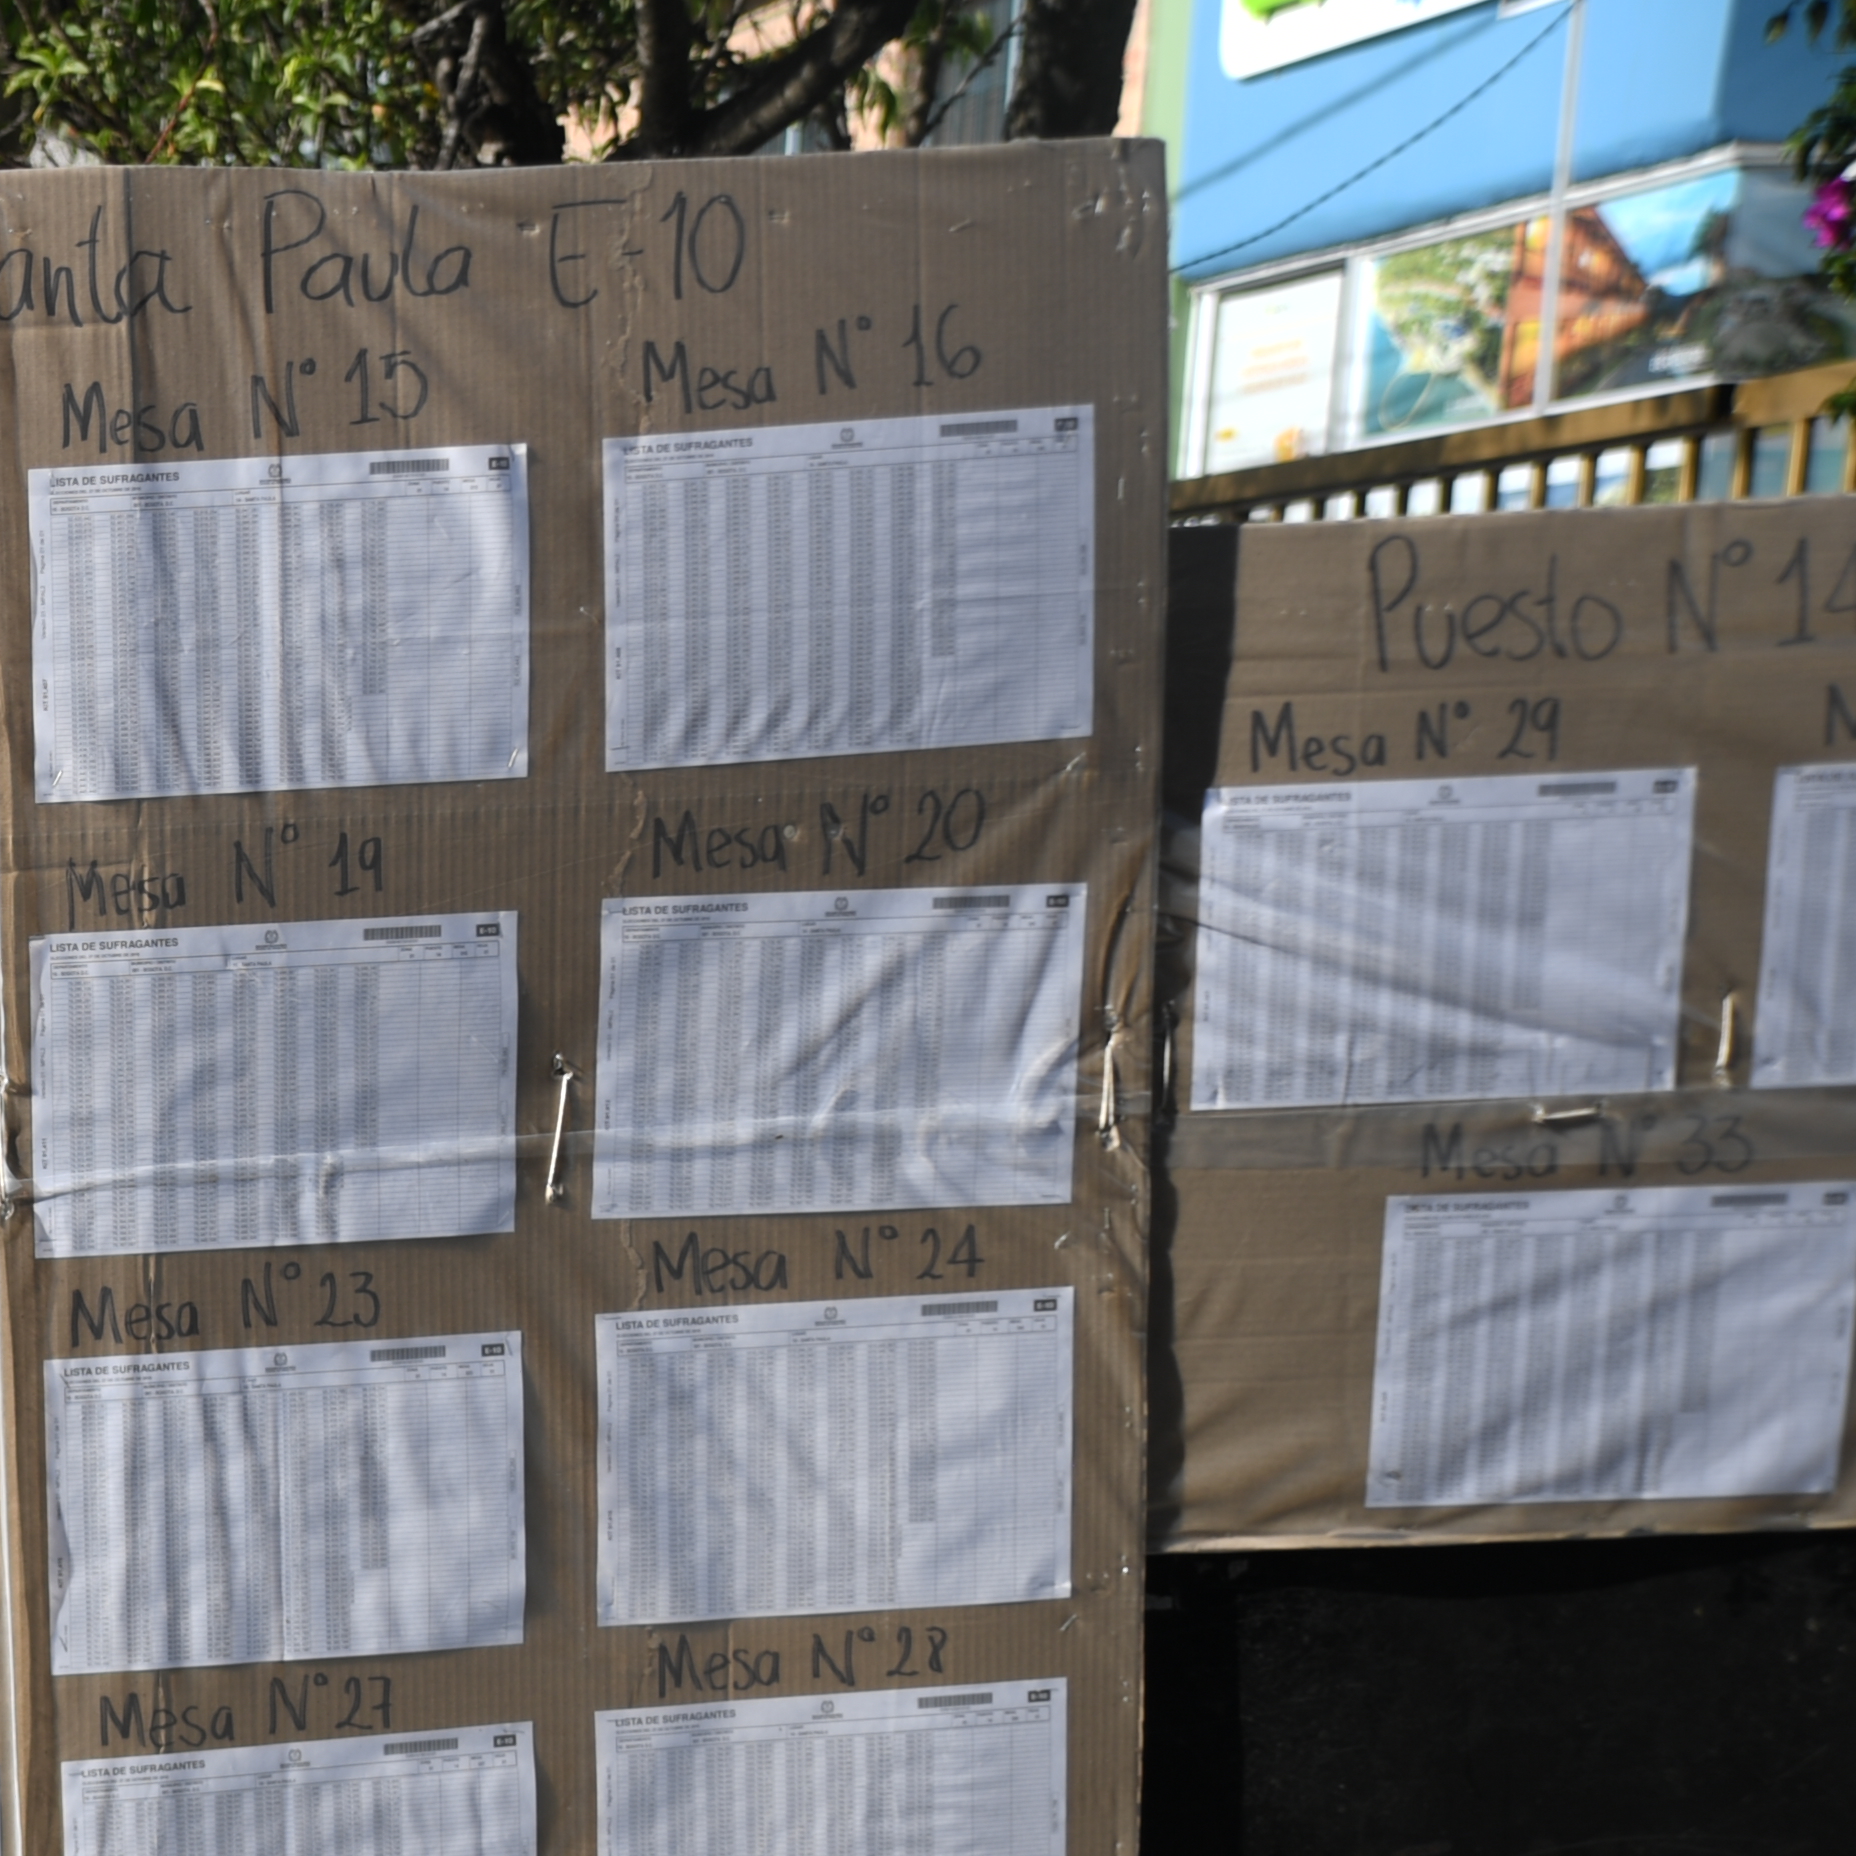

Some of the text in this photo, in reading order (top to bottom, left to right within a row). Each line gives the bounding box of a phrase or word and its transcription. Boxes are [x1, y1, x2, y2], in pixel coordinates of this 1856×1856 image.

[261, 188, 473, 314] Paula
[548, 190, 746, 309] E-10
[641, 340, 777, 415] Mesa
[902, 304, 982, 387] 16
[61, 380, 204, 455] Mesa
[345, 347, 428, 426] 15
[82, 475, 97, 486] DE
[100, 472, 180, 485] SUFRAGANTES
[1368, 535, 1622, 673] Puesto
[1250, 701, 1386, 776] Mesa
[1497, 696, 1561, 760] 29
[652, 809, 788, 880] Mesa
[904, 787, 987, 864] 20
[65, 856, 187, 932] Mesa
[329, 831, 385, 898] 19
[82, 941, 96, 951] DE
[99, 938, 179, 950] SUFRAGANTES
[1420, 1121, 1558, 1182] Mesa
[1675, 1113, 1755, 1176] 33
[652, 1231, 790, 1296] Mesa
[916, 1223, 985, 1281] 24
[71, 1286, 199, 1348] Mesa
[314, 1271, 381, 1328] 23
[646, 1319, 660, 1329] DE
[662, 1314, 739, 1328] SUFRAGANTES
[95, 1366, 110, 1376] DE
[112, 1362, 190, 1375] SUFRAGANTES
[656, 1634, 781, 1698] Mesa
[886, 1626, 948, 1676] 28
[99, 1692, 235, 1749] Mesa
[335, 1675, 393, 1730] 27
